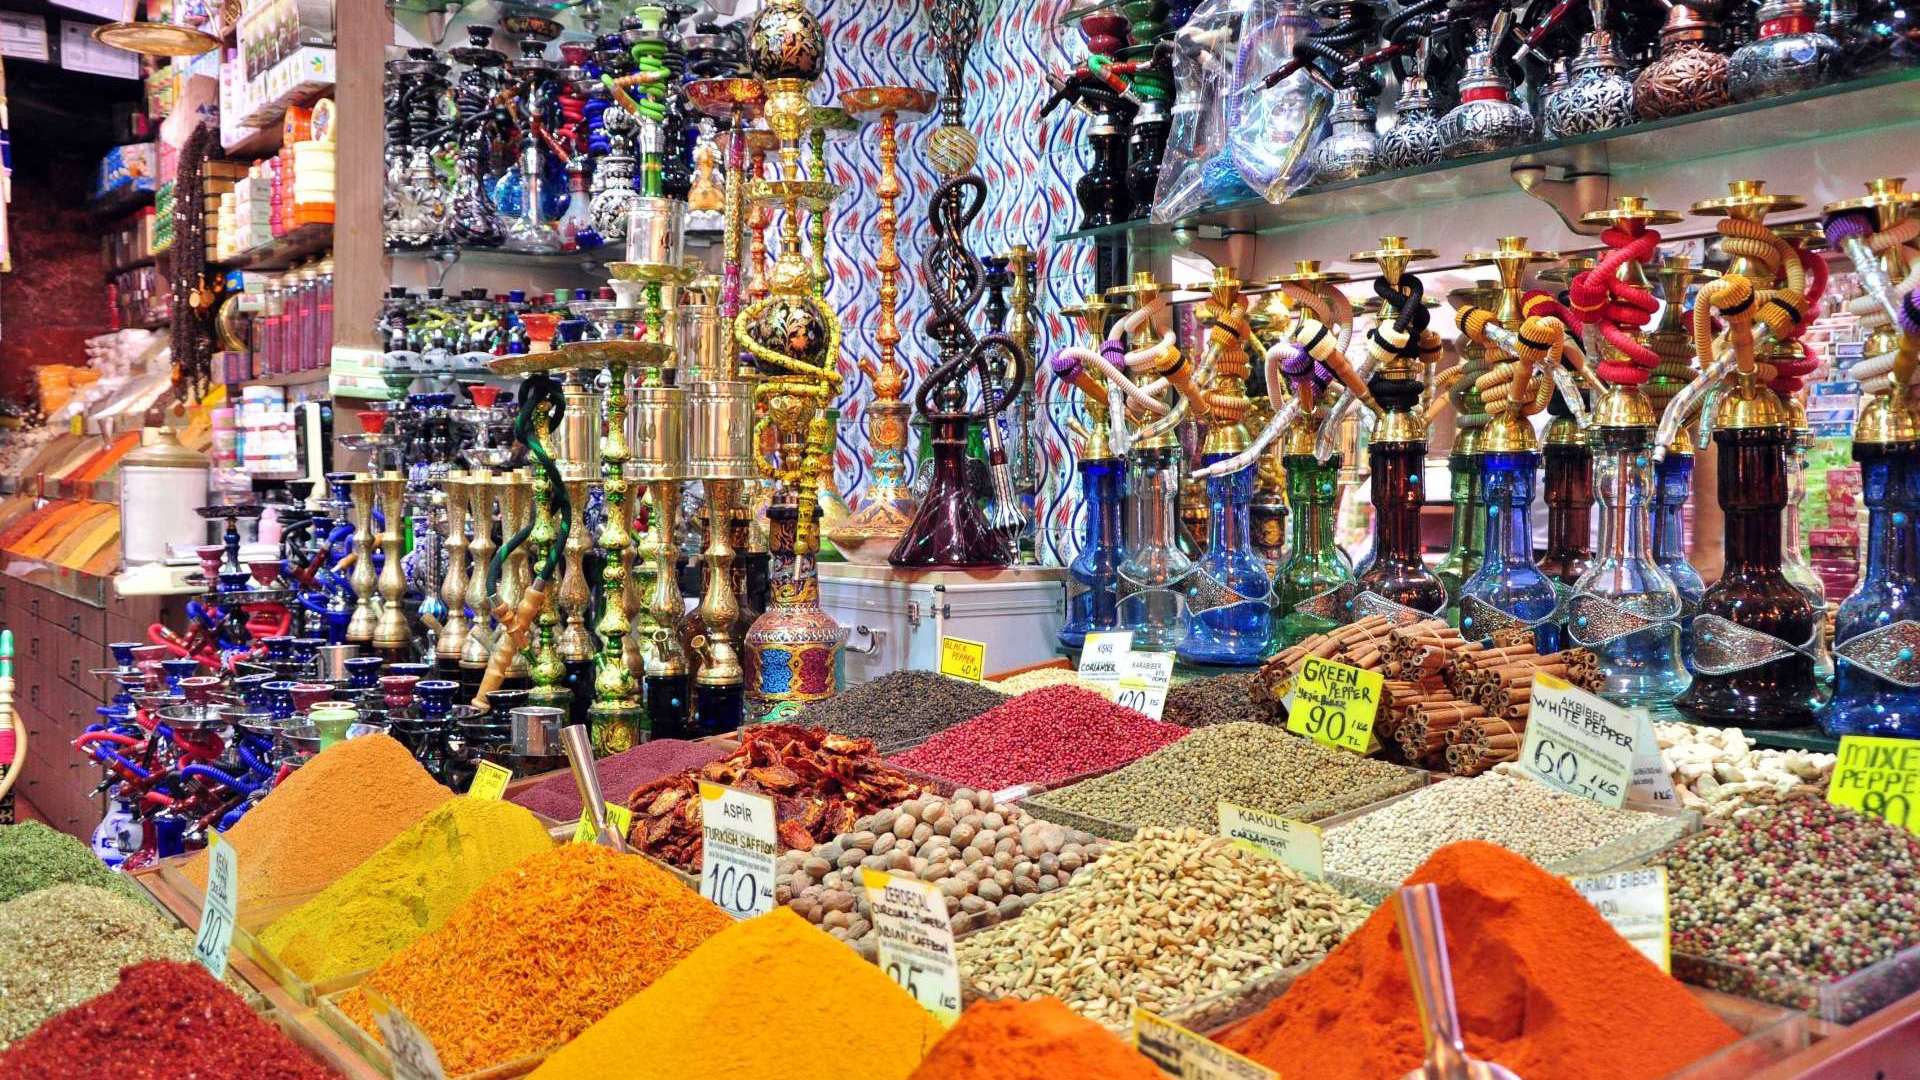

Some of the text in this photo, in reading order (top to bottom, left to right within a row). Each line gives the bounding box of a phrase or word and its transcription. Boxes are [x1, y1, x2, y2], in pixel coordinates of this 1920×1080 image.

[1303, 659, 1359, 689] GREEN
[1328, 682, 1372, 704] PEPPER
[1305, 706, 1346, 741] 90
[1532, 694, 1634, 752] WHITE PEPPER
[1346, 735, 1361, 746] TL
[1534, 739, 1578, 785] 60
[1843, 744, 1920, 772] MIXE
[1838, 769, 1920, 794] PEPPE
[723, 802, 753, 823] ASPİR
[1238, 809, 1290, 833] KAKULE
[704, 826, 776, 856] TURKISH SAFFRON
[709, 863, 757, 912] 100
[199, 907, 222, 957] 20
